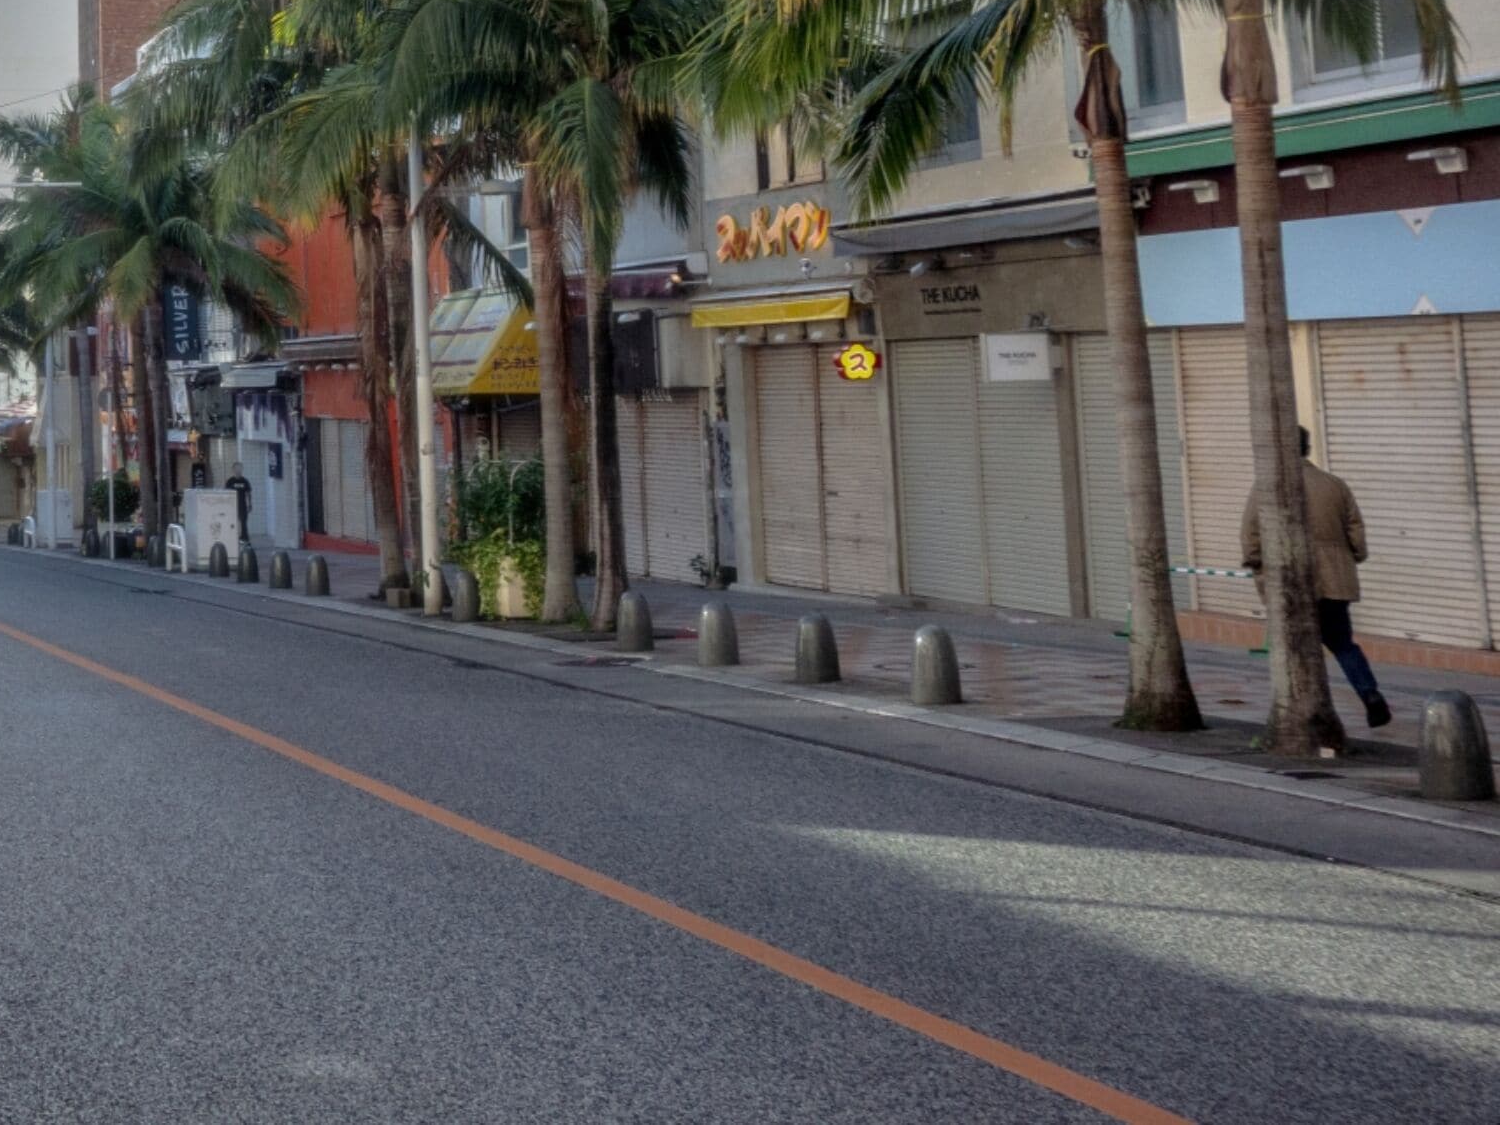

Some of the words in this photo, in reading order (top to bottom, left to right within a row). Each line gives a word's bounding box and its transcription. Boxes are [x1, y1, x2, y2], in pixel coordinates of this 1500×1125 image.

[716, 200, 832, 264] スッパイマン
[171, 282, 191, 355] SILVER
[920, 287, 941, 305] THE
[943, 284, 982, 304] KUCHA
